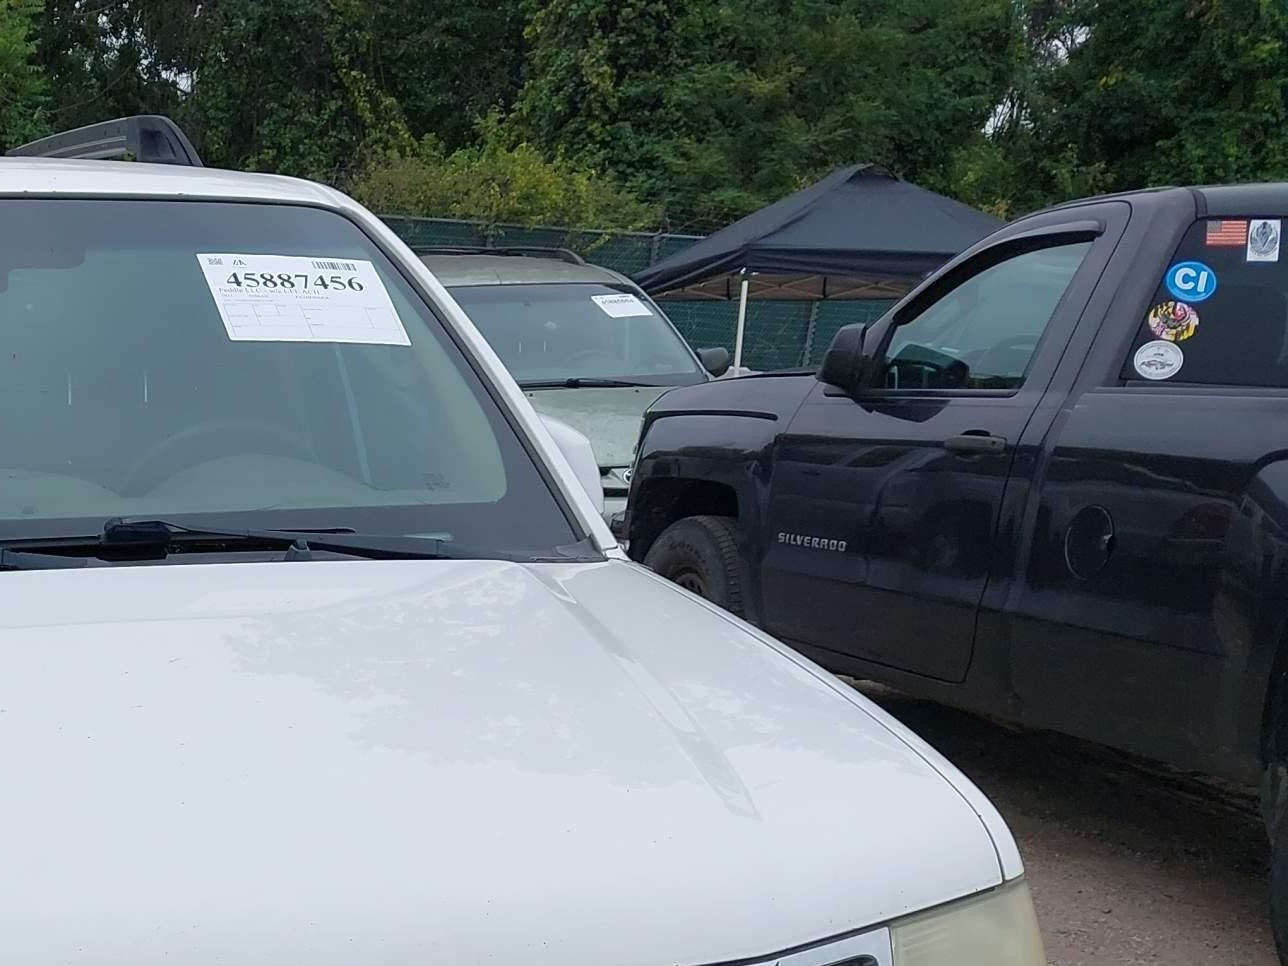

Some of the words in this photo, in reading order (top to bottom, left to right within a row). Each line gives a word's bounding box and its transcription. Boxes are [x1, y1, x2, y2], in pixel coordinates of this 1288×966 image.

[226, 271, 365, 292] 45887456
[1174, 267, 1209, 293] CI
[777, 532, 847, 552] SILVERADO
